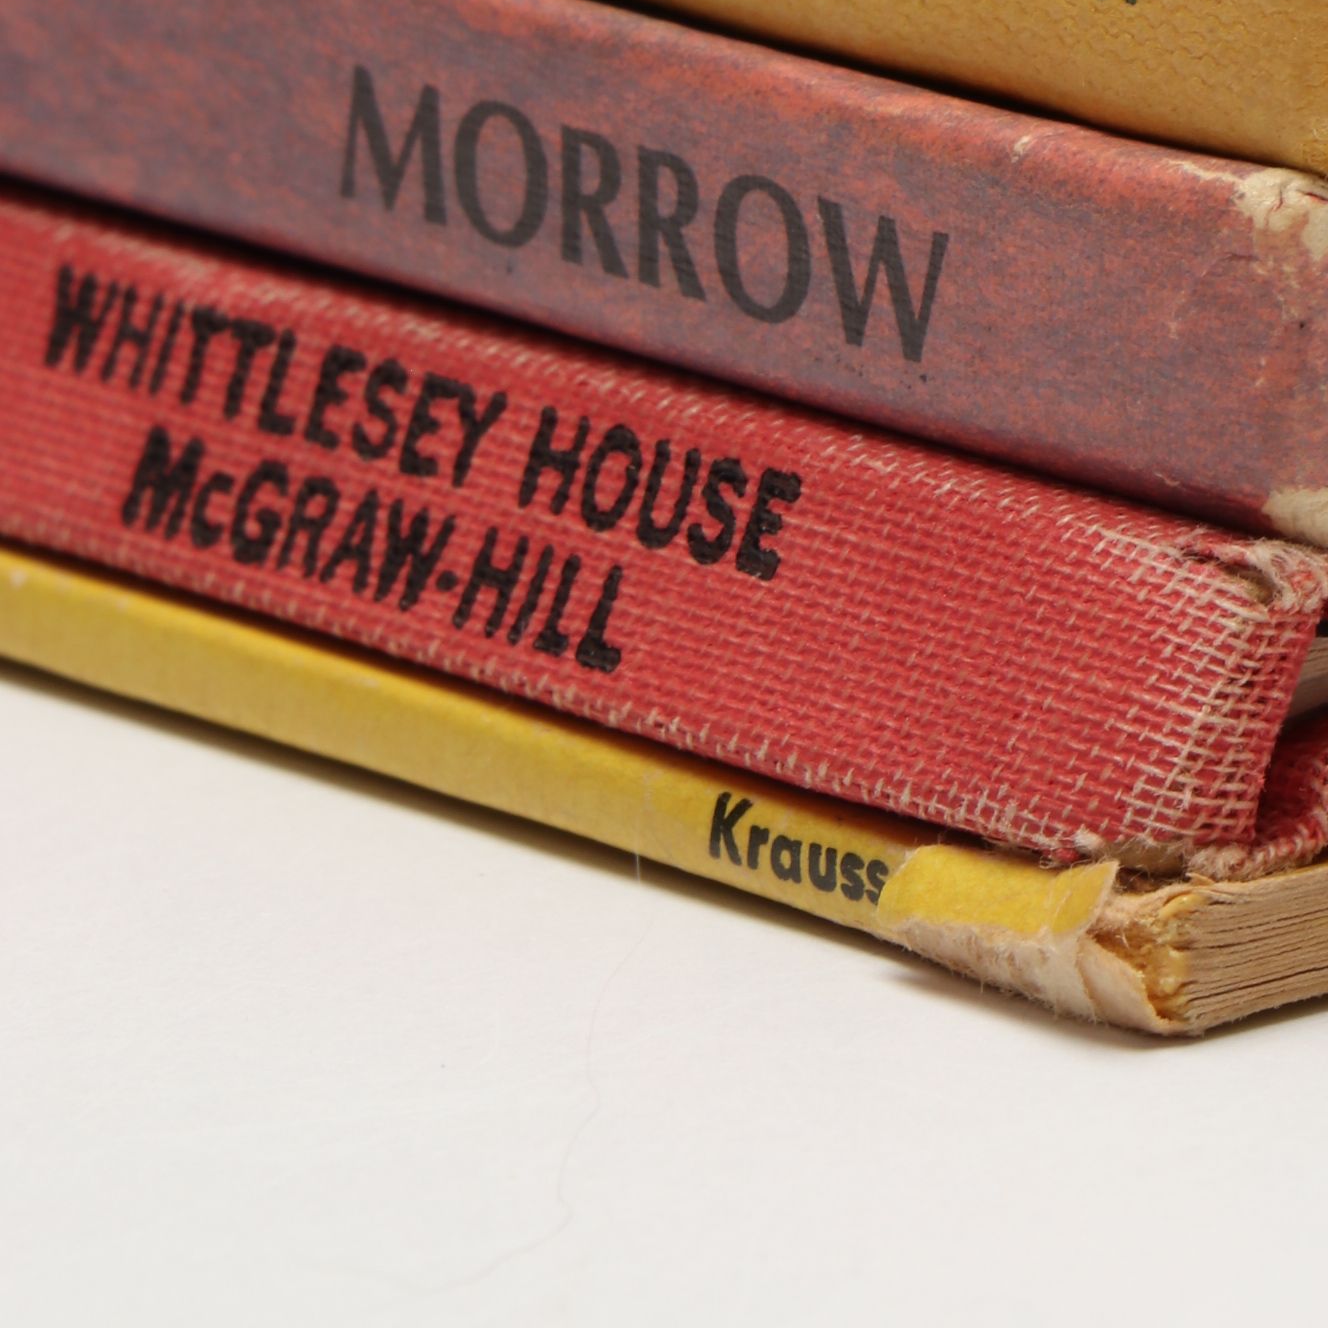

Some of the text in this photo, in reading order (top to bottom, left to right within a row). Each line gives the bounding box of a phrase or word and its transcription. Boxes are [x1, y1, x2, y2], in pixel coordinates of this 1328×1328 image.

[341, 63, 950, 363] MORROW
[43, 263, 803, 582] WHITTLESEY HOUSE
